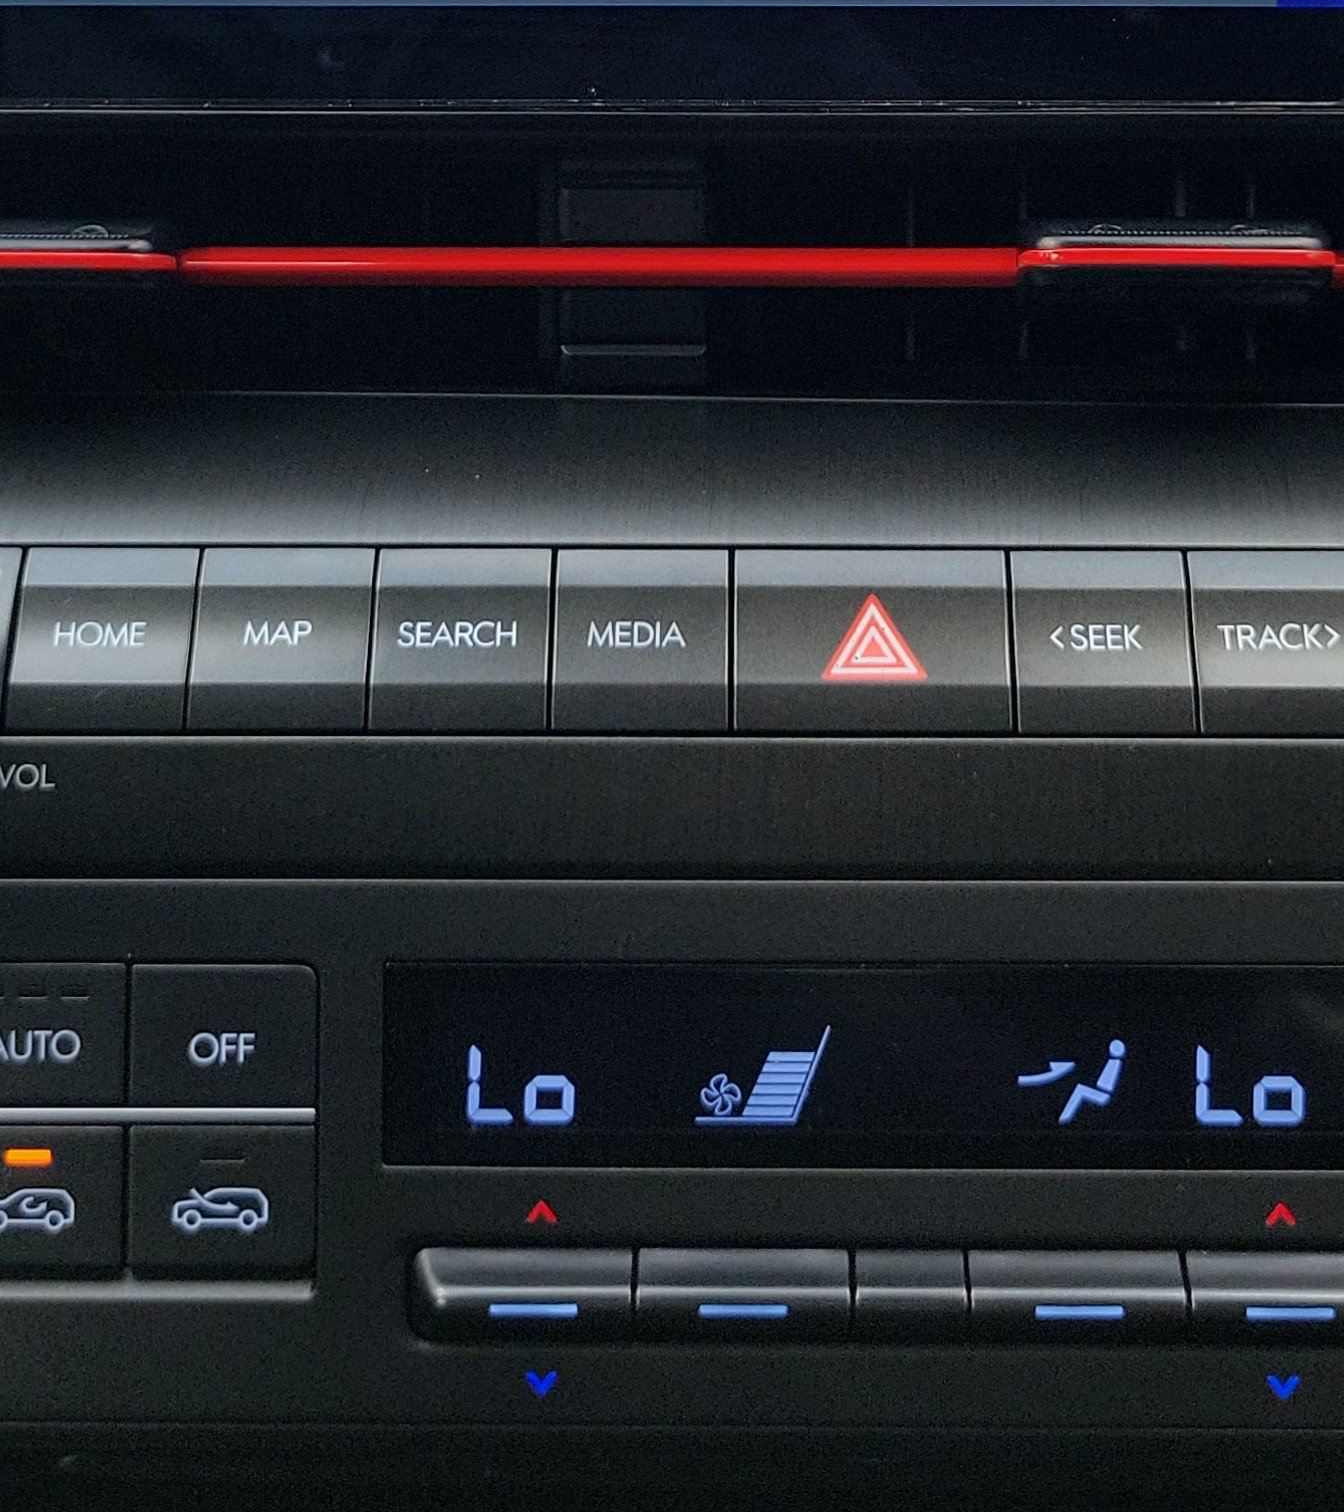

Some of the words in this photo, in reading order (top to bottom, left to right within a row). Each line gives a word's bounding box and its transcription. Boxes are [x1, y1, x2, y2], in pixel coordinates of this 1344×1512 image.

[53, 621, 148, 648] HOME
[242, 621, 312, 647] MAP
[397, 621, 519, 648] SEARCH
[586, 621, 687, 648] MEDIA
[187, 1032, 256, 1067] OFF
